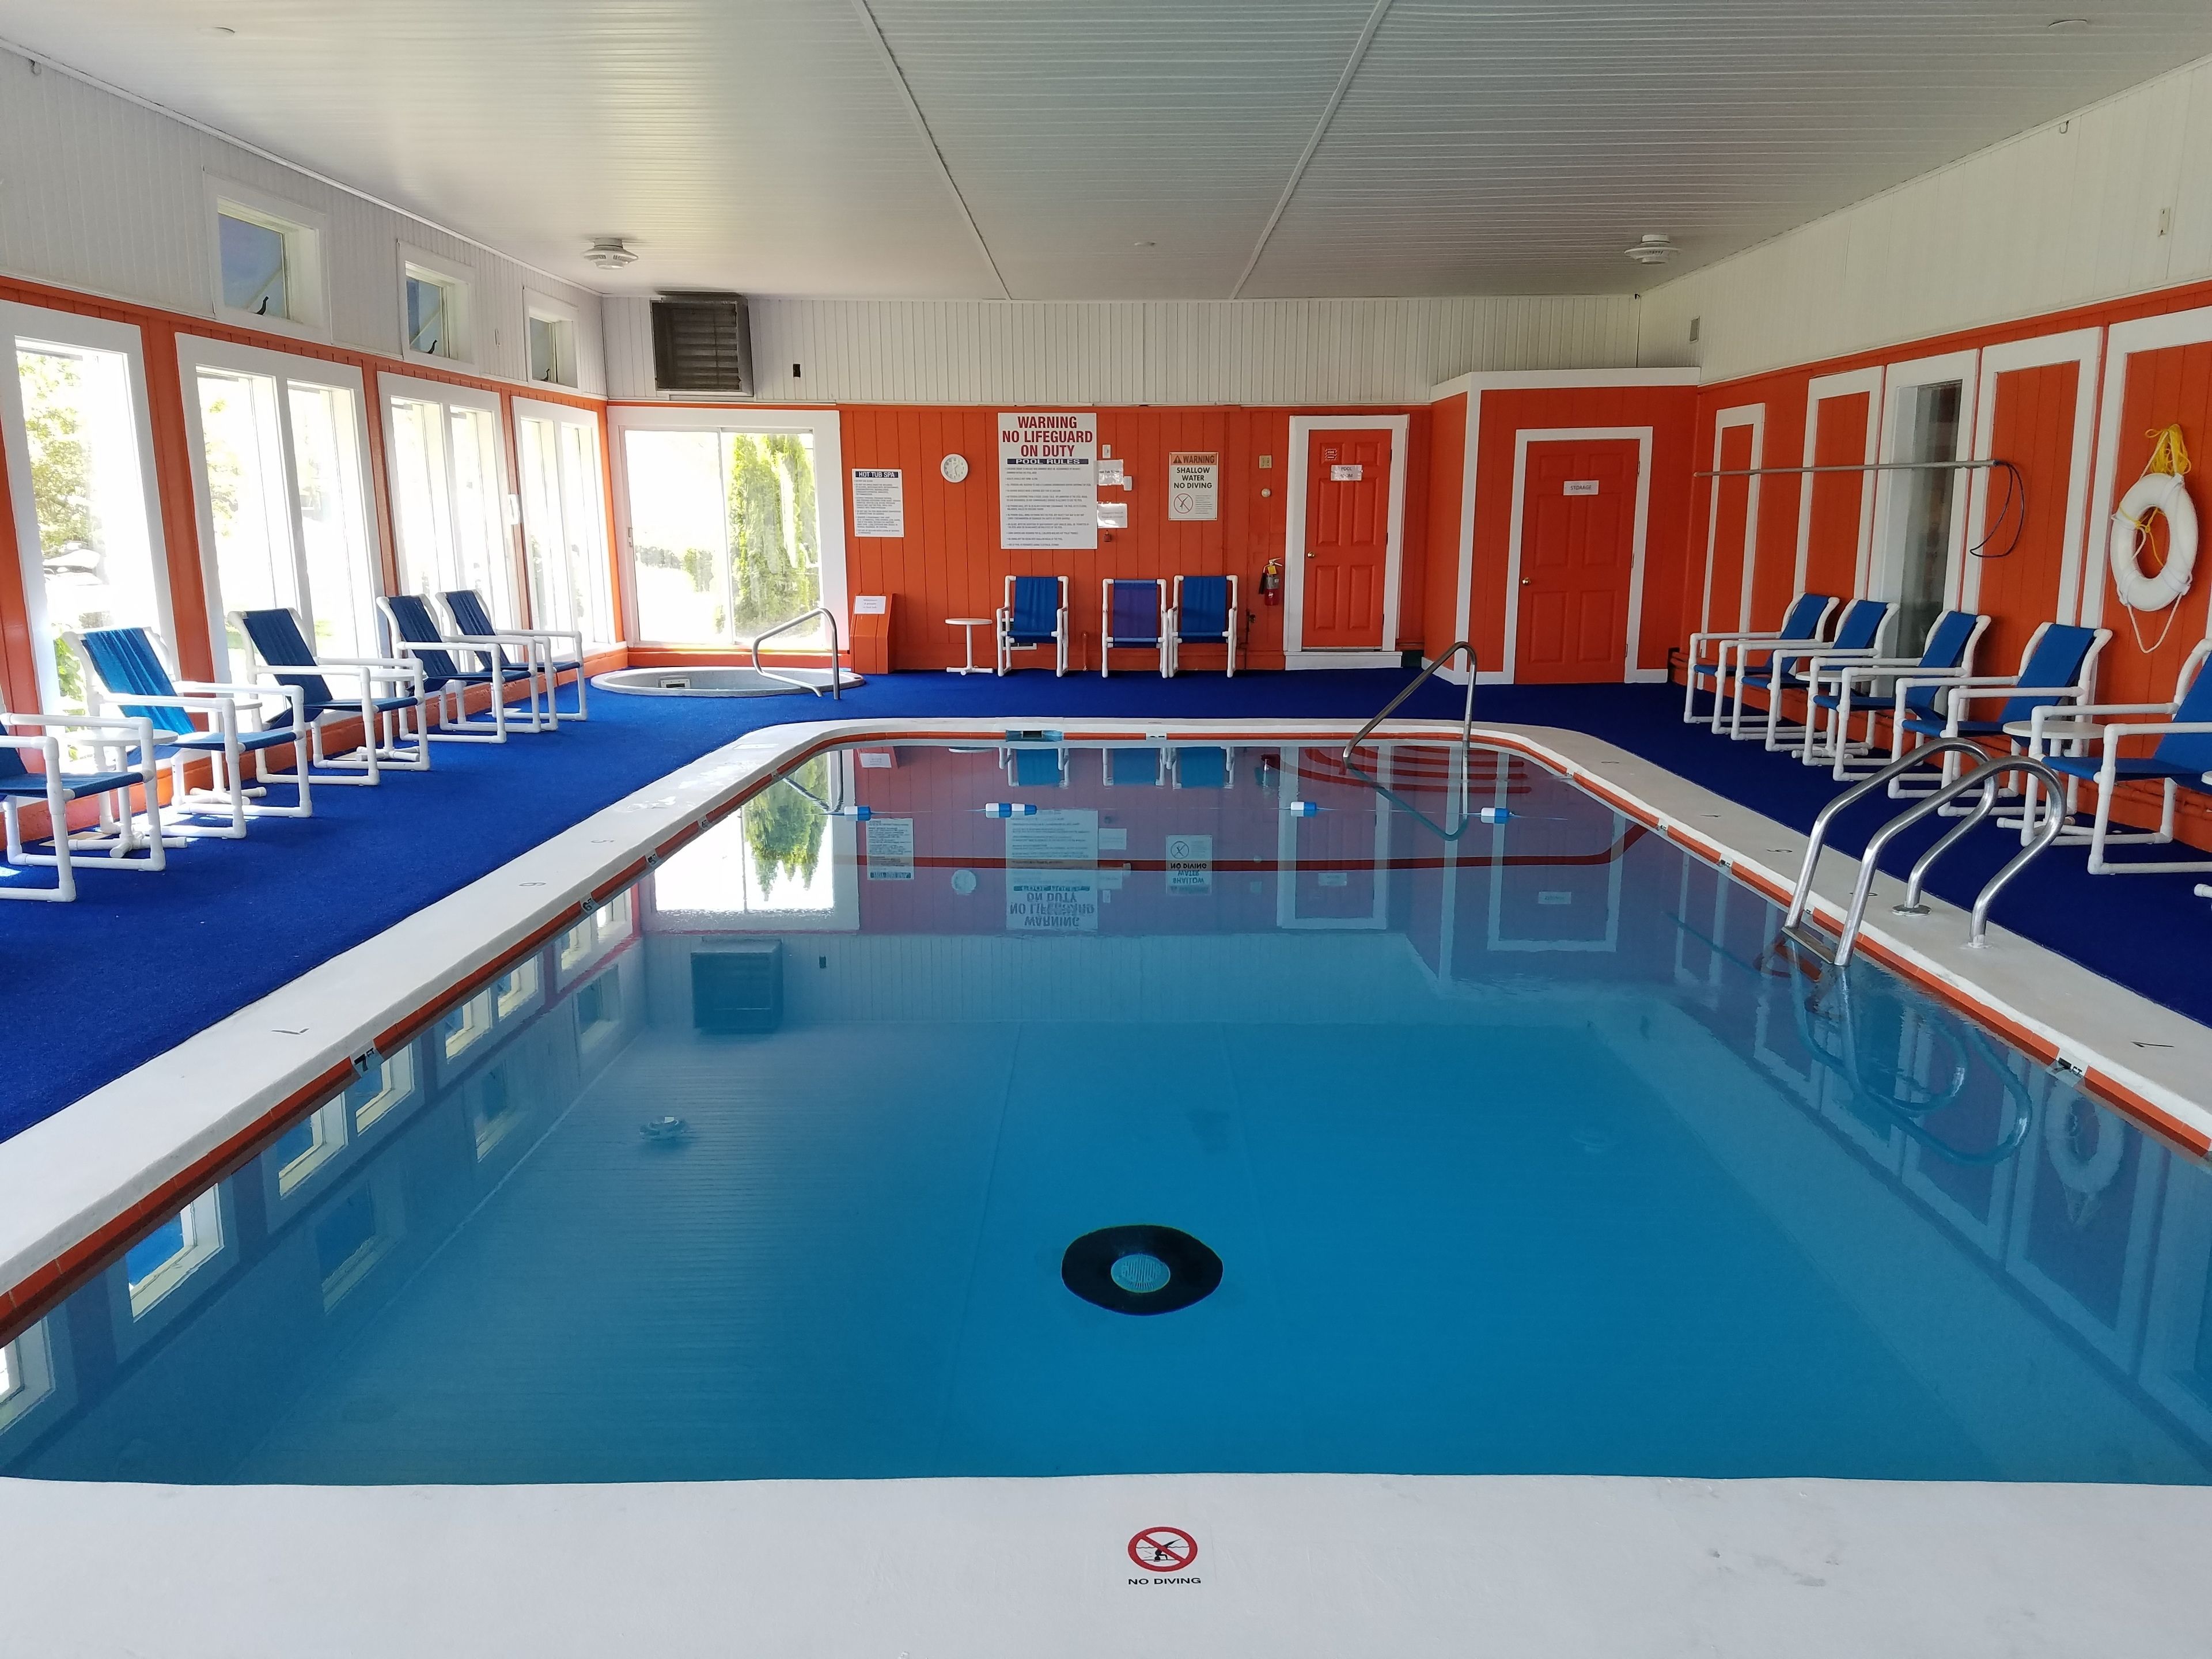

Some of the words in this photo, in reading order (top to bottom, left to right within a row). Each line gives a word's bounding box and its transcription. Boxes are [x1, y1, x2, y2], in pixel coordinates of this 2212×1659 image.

[1017, 416, 1077, 429] WARNING
[1002, 430, 1020, 443] NO
[1024, 430, 1093, 443] LIFEGUARD
[1021, 444, 1037, 457] ON
[1043, 445, 1075, 457] DUTY
[1183, 455, 1215, 464] WARNING
